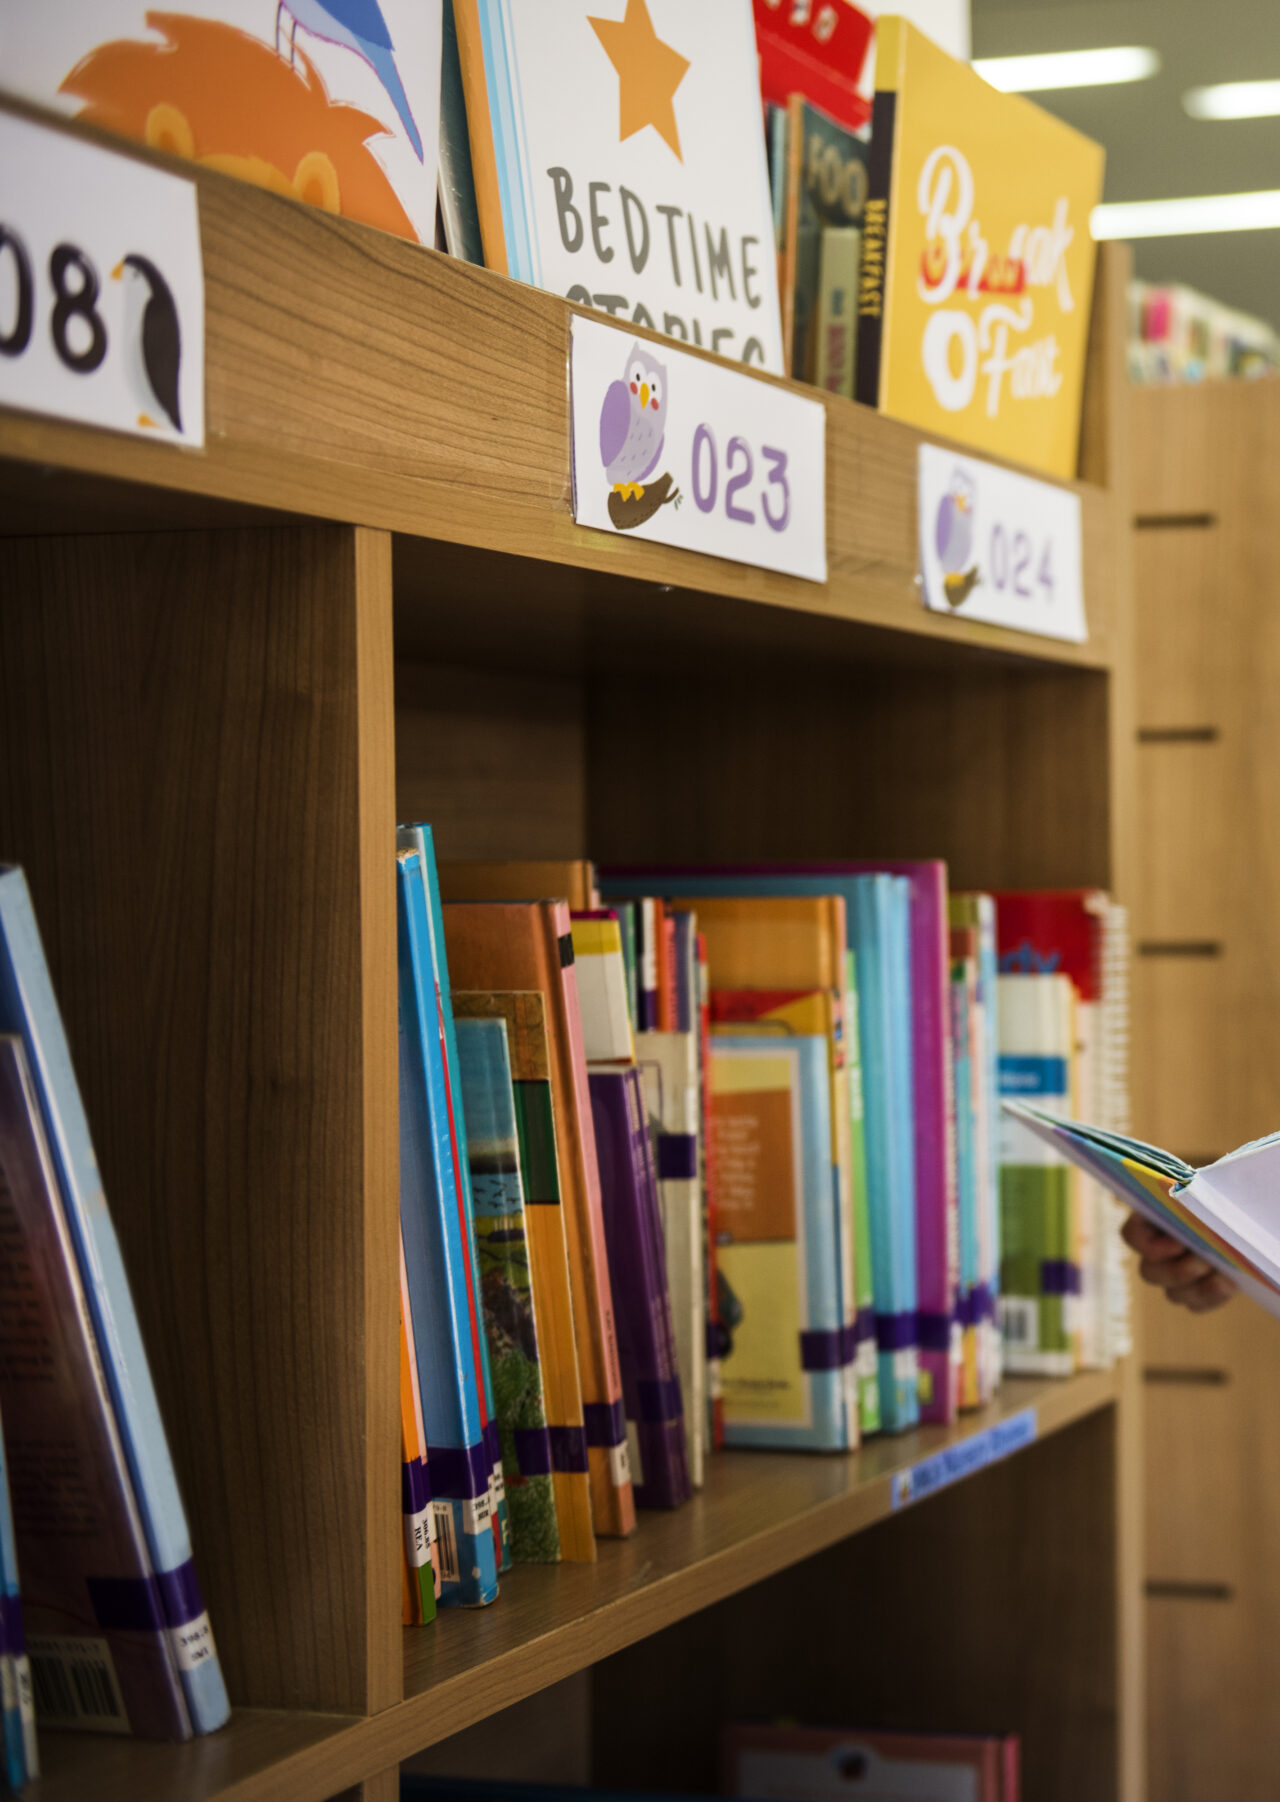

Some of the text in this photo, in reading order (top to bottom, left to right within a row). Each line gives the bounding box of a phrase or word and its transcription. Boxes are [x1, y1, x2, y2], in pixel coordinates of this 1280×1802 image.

[547, 166, 764, 310] BEDTIME
[691, 422, 790, 532] 023
[989, 520, 1053, 604] 024
